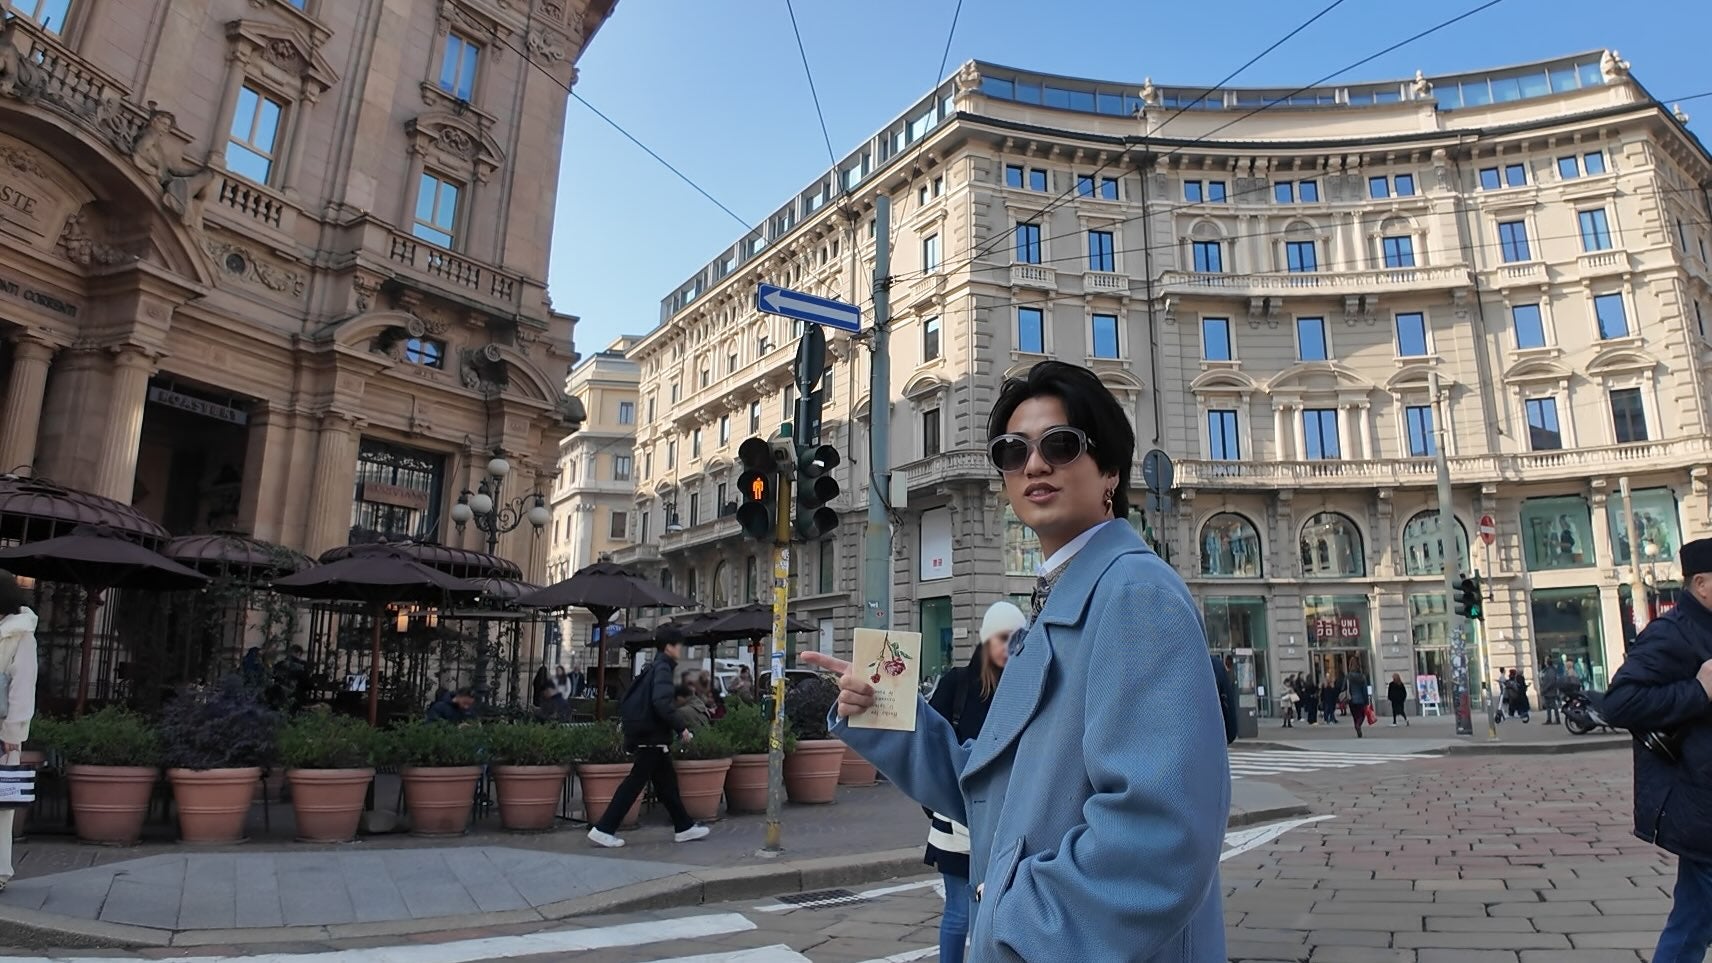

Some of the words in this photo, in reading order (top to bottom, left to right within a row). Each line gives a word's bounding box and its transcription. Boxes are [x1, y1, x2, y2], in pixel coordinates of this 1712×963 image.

[0, 185, 38, 214] STE
[1341, 619, 1356, 627] UNI
[1342, 628, 1358, 637] QLO
